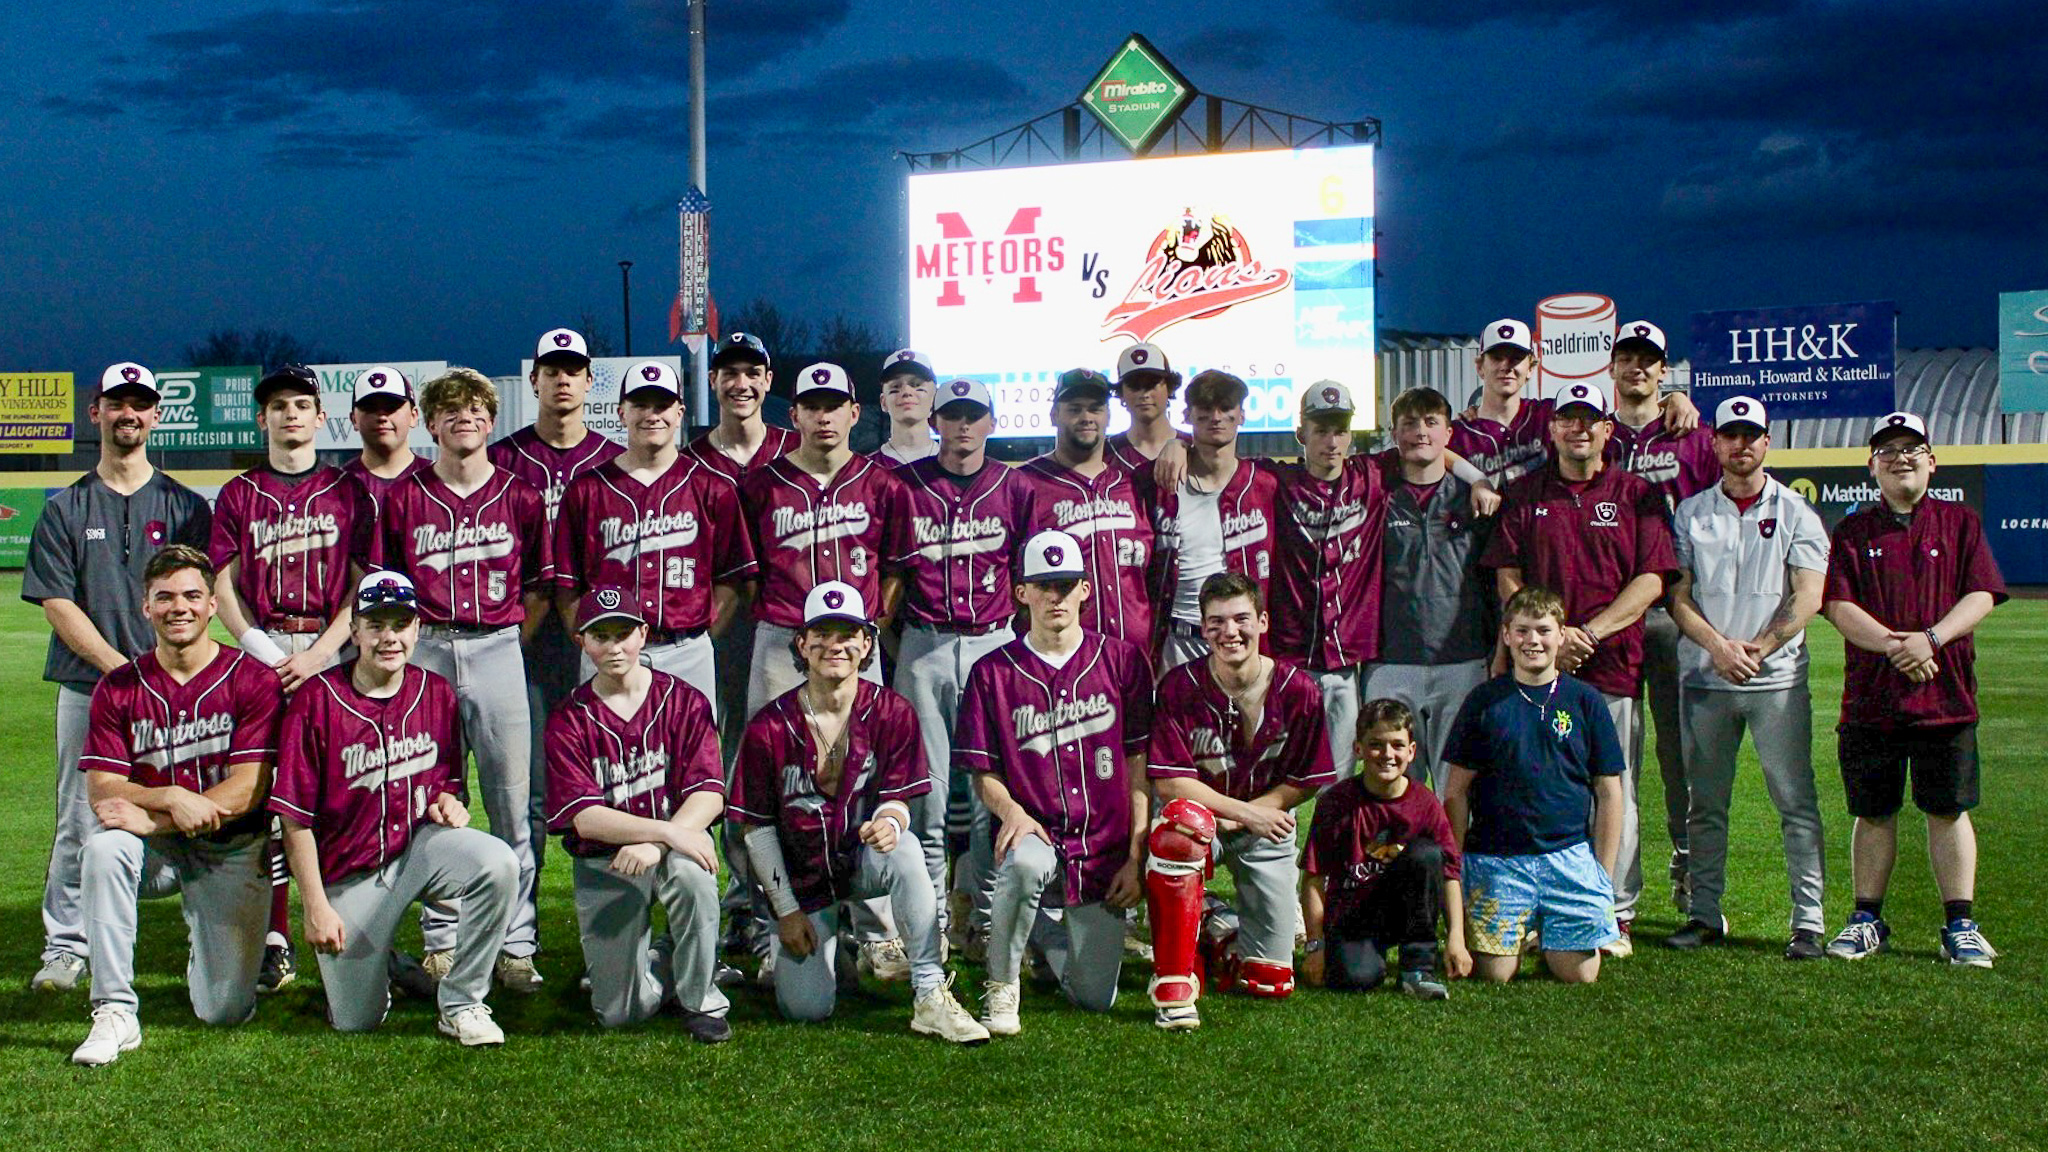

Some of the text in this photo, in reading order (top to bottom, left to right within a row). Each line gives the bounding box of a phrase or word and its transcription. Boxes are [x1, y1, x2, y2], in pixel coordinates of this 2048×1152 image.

[1108, 102, 1160, 113] STADIUM
[1320, 174, 1345, 215] 6
[916, 237, 1064, 278] METEORS
[695, 234, 706, 326] FIREWORKS
[1542, 330, 1612, 356] meldrim's
[1728, 323, 1859, 364] HH&K
[18, 378, 67, 397] HILL
[225, 378, 252, 391] PRIDE
[1694, 372, 1756, 388] Hinman,
[1759, 367, 1812, 385] Howard
[1815, 367, 1828, 382] &
[1832, 365, 1878, 382] Kattell
[2, 399, 67, 409] VINEYARDS
[214, 393, 253, 407] QUALITY
[1761, 391, 1828, 401] ATTORNEYS
[223, 407, 252, 421] METAL
[3, 425, 67, 437] LAUGHTER!
[180, 431, 234, 446] PRECISION
[238, 431, 256, 444] INC
[1821, 482, 1881, 502] Matthe
[1927, 487, 1964, 501] ssan
[773, 501, 867, 538] Montrose
[1053, 496, 1132, 525] Montrose
[249, 512, 336, 549] Montrose
[413, 521, 510, 556] Montrose
[600, 510, 697, 549] Montrose
[913, 516, 1002, 544] Montrose
[666, 556, 696, 589] 25
[850, 546, 867, 577] 3
[487, 570, 508, 602] 5
[1012, 692, 1108, 739] Montrose
[131, 711, 234, 753] Montrose
[1094, 745, 1114, 780] 6
